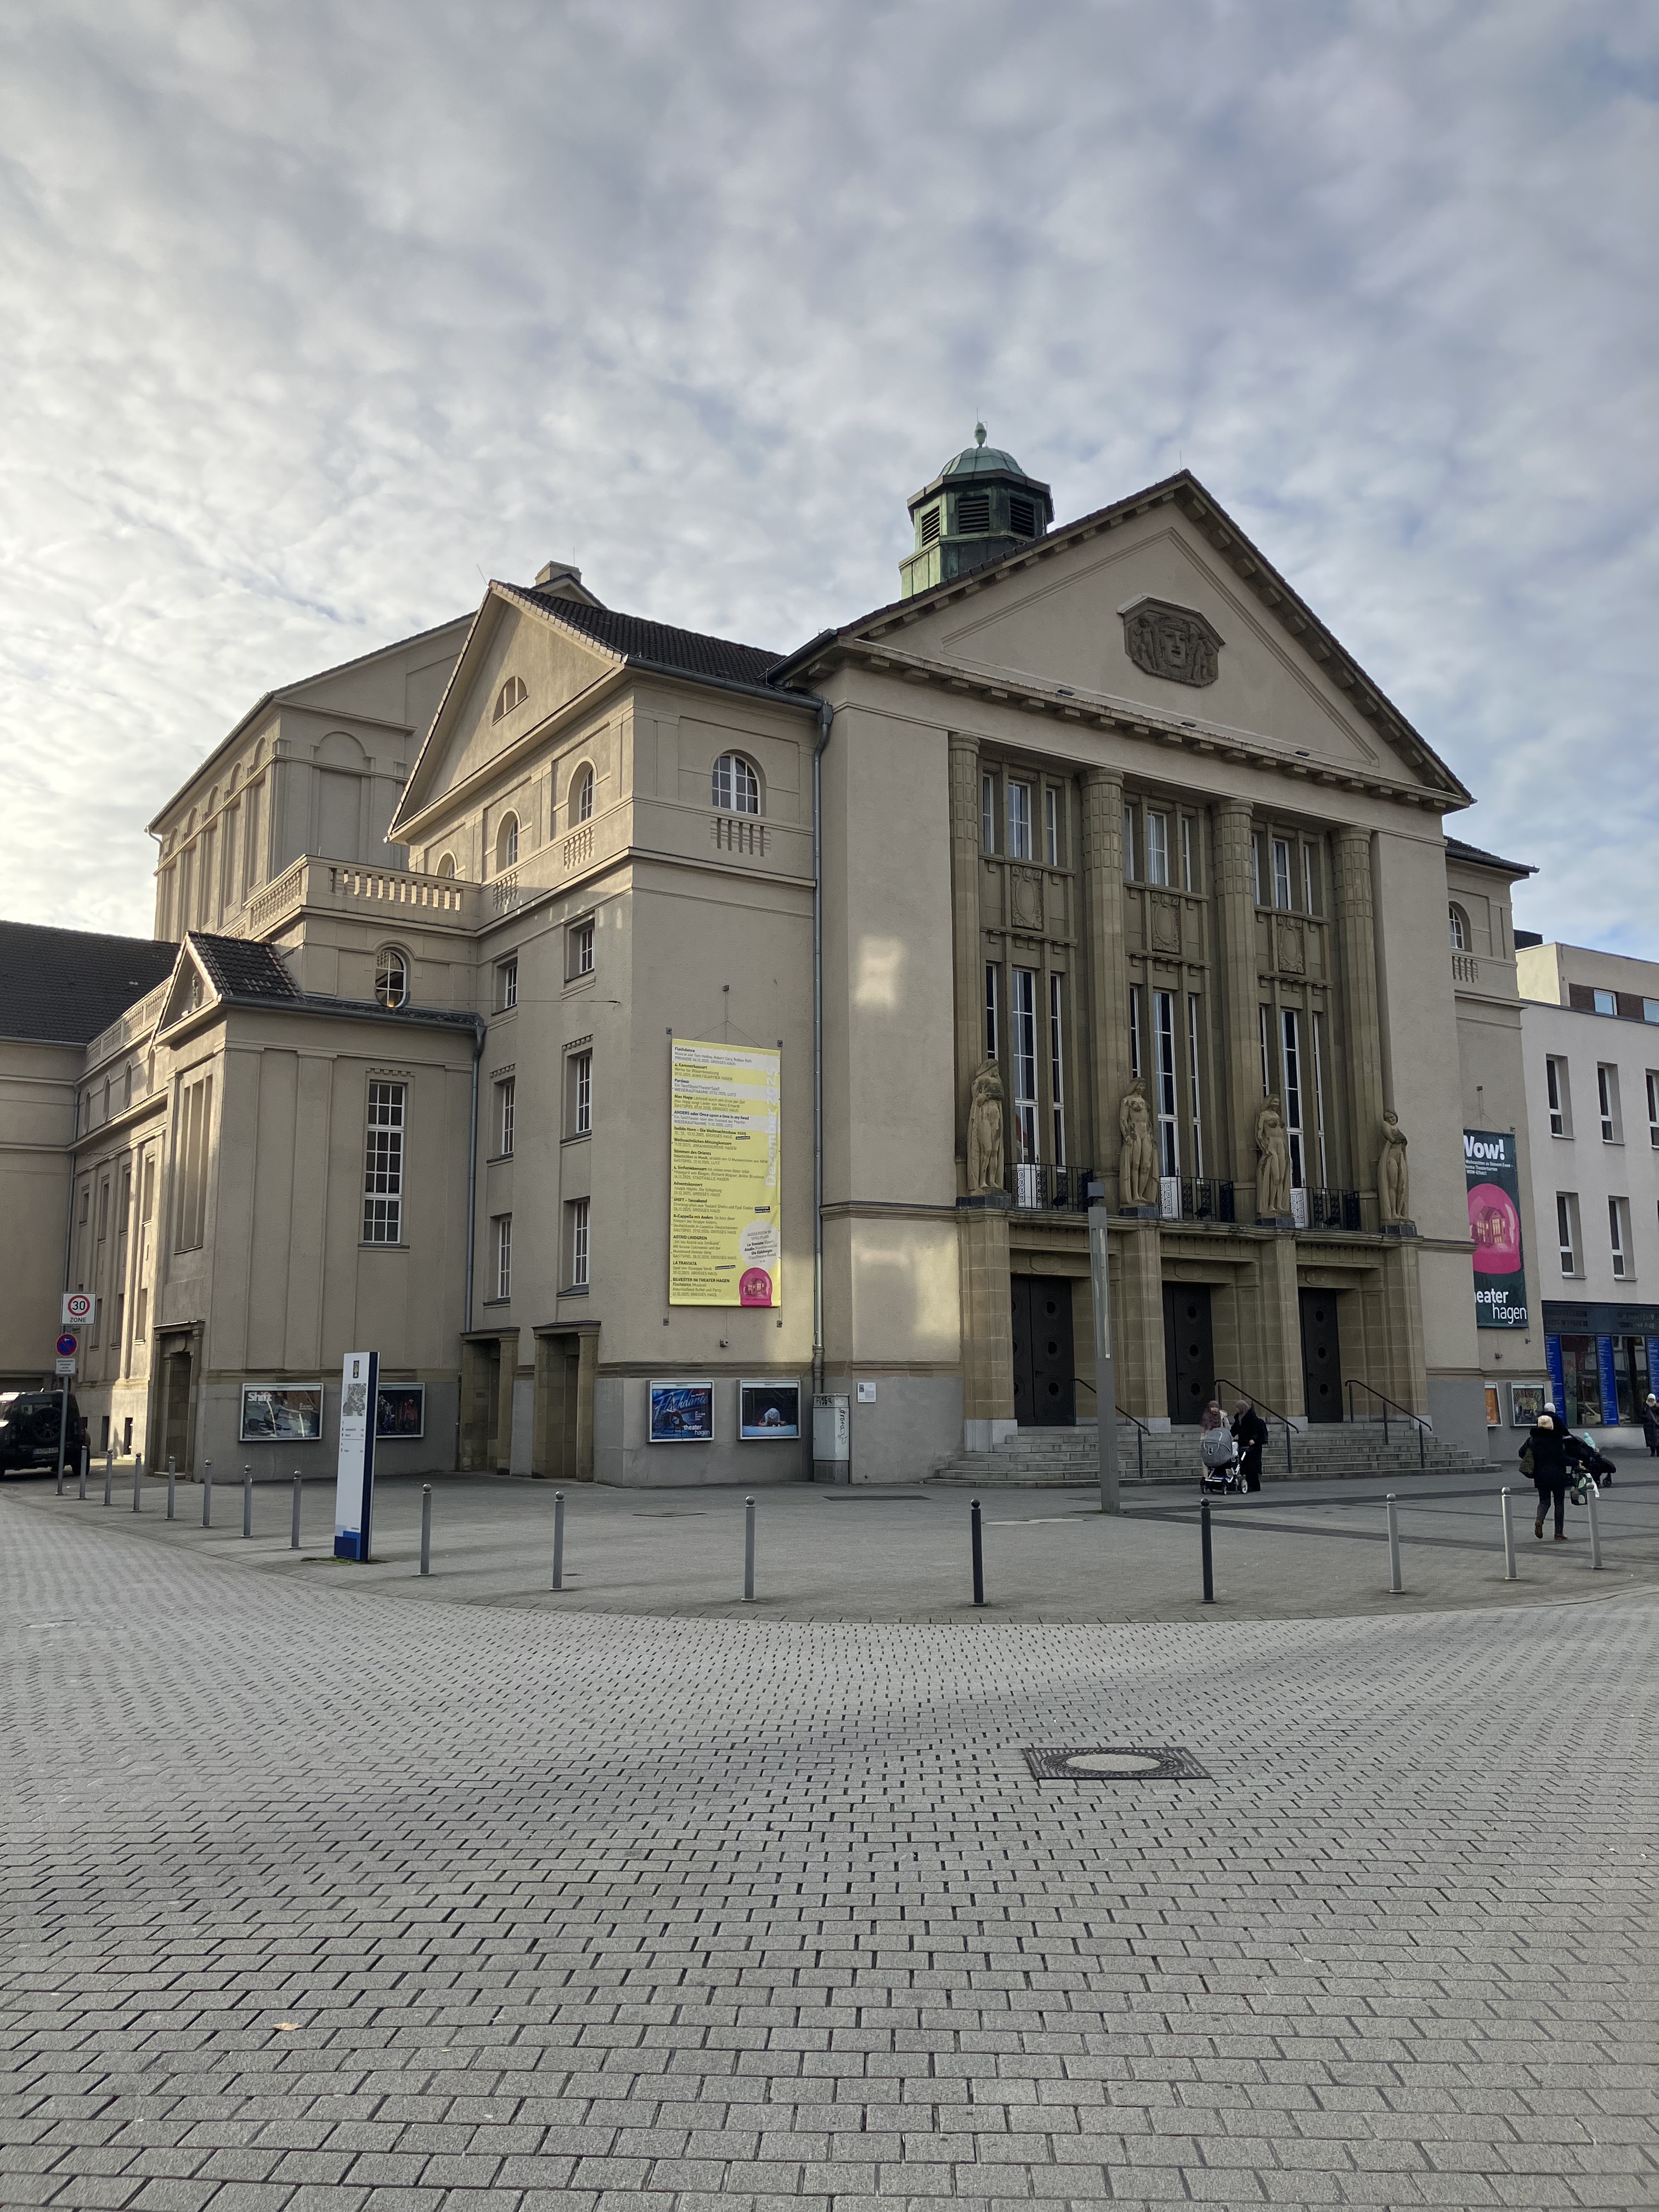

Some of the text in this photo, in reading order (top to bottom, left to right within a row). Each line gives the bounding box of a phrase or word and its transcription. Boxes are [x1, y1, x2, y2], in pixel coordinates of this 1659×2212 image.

[765, 1068, 777, 1186] Dezember 2025
[1474, 1288, 1509, 1304] eater
[72, 1301, 86, 1310] 30
[1492, 1303, 1527, 1324] hagen
[248, 1391, 272, 1402] Shift
